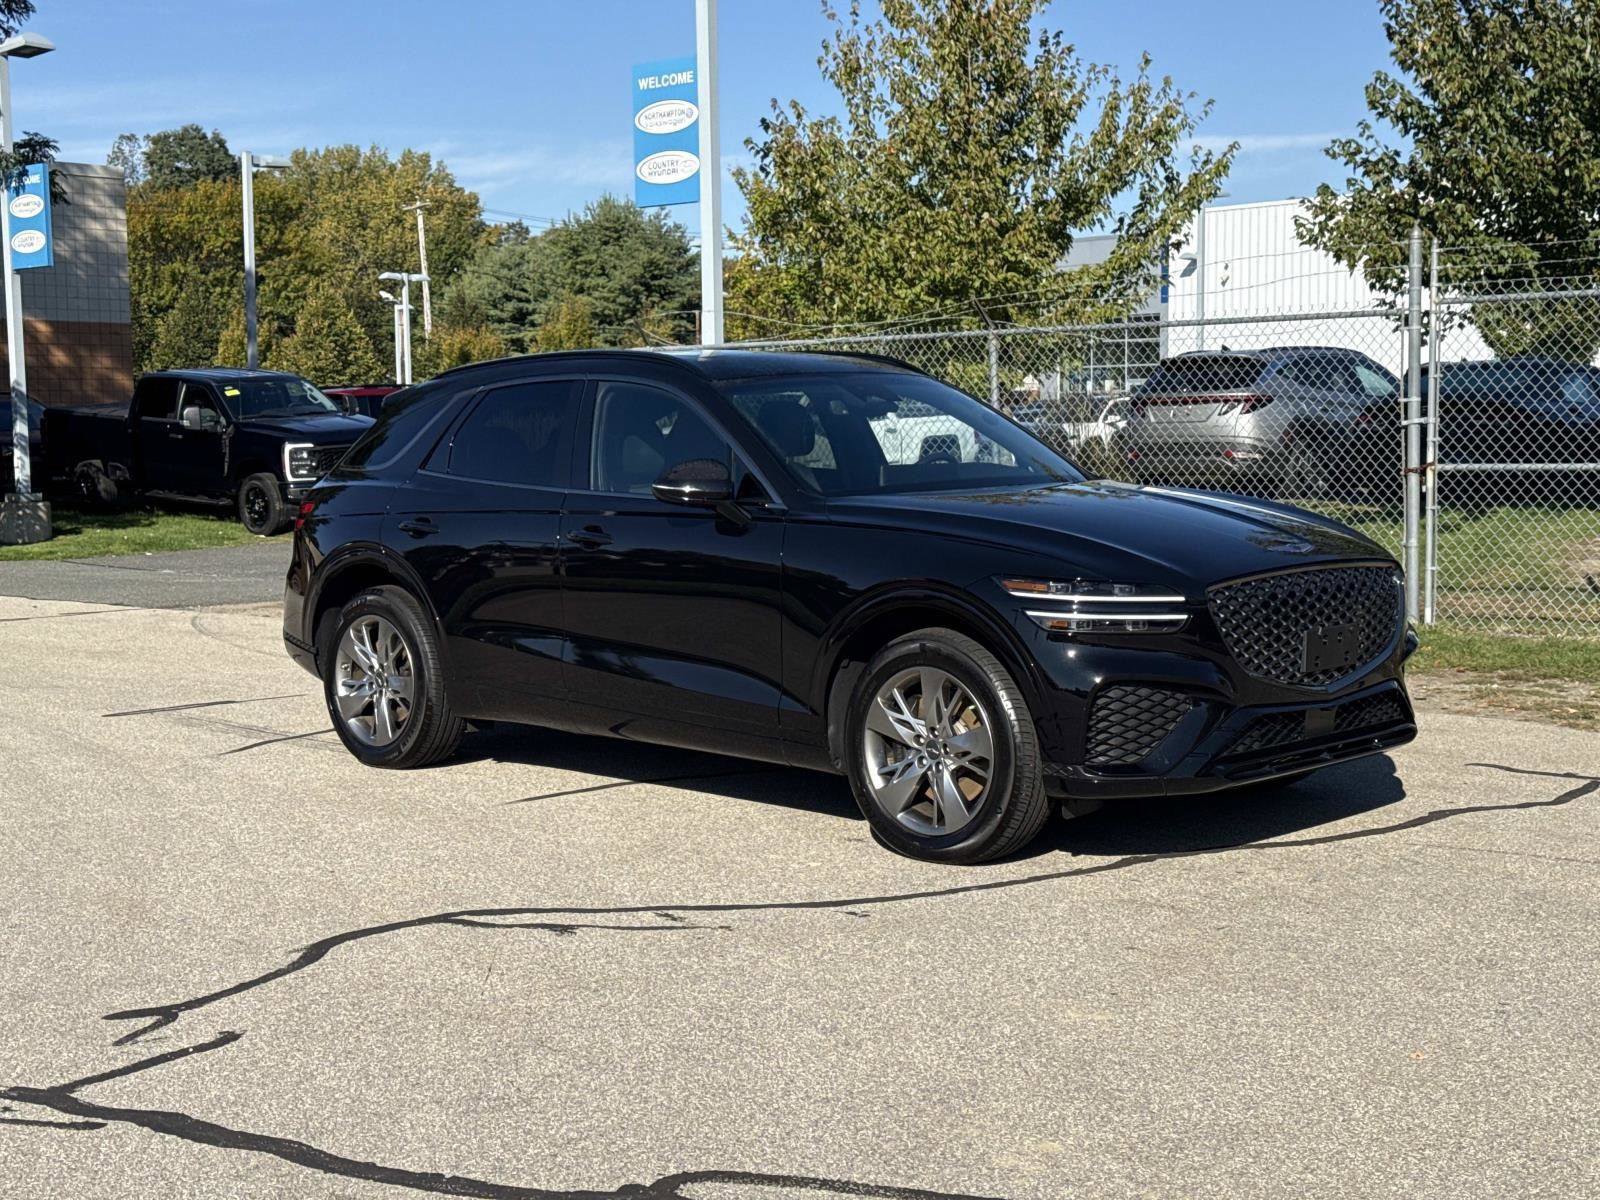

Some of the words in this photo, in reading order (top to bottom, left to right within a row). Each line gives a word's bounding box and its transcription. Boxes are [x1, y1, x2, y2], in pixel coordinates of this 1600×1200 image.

[638, 71, 695, 90] WELCOME
[644, 108, 686, 120] NORTHAMPTON
[648, 160, 679, 170] COUNTRY
